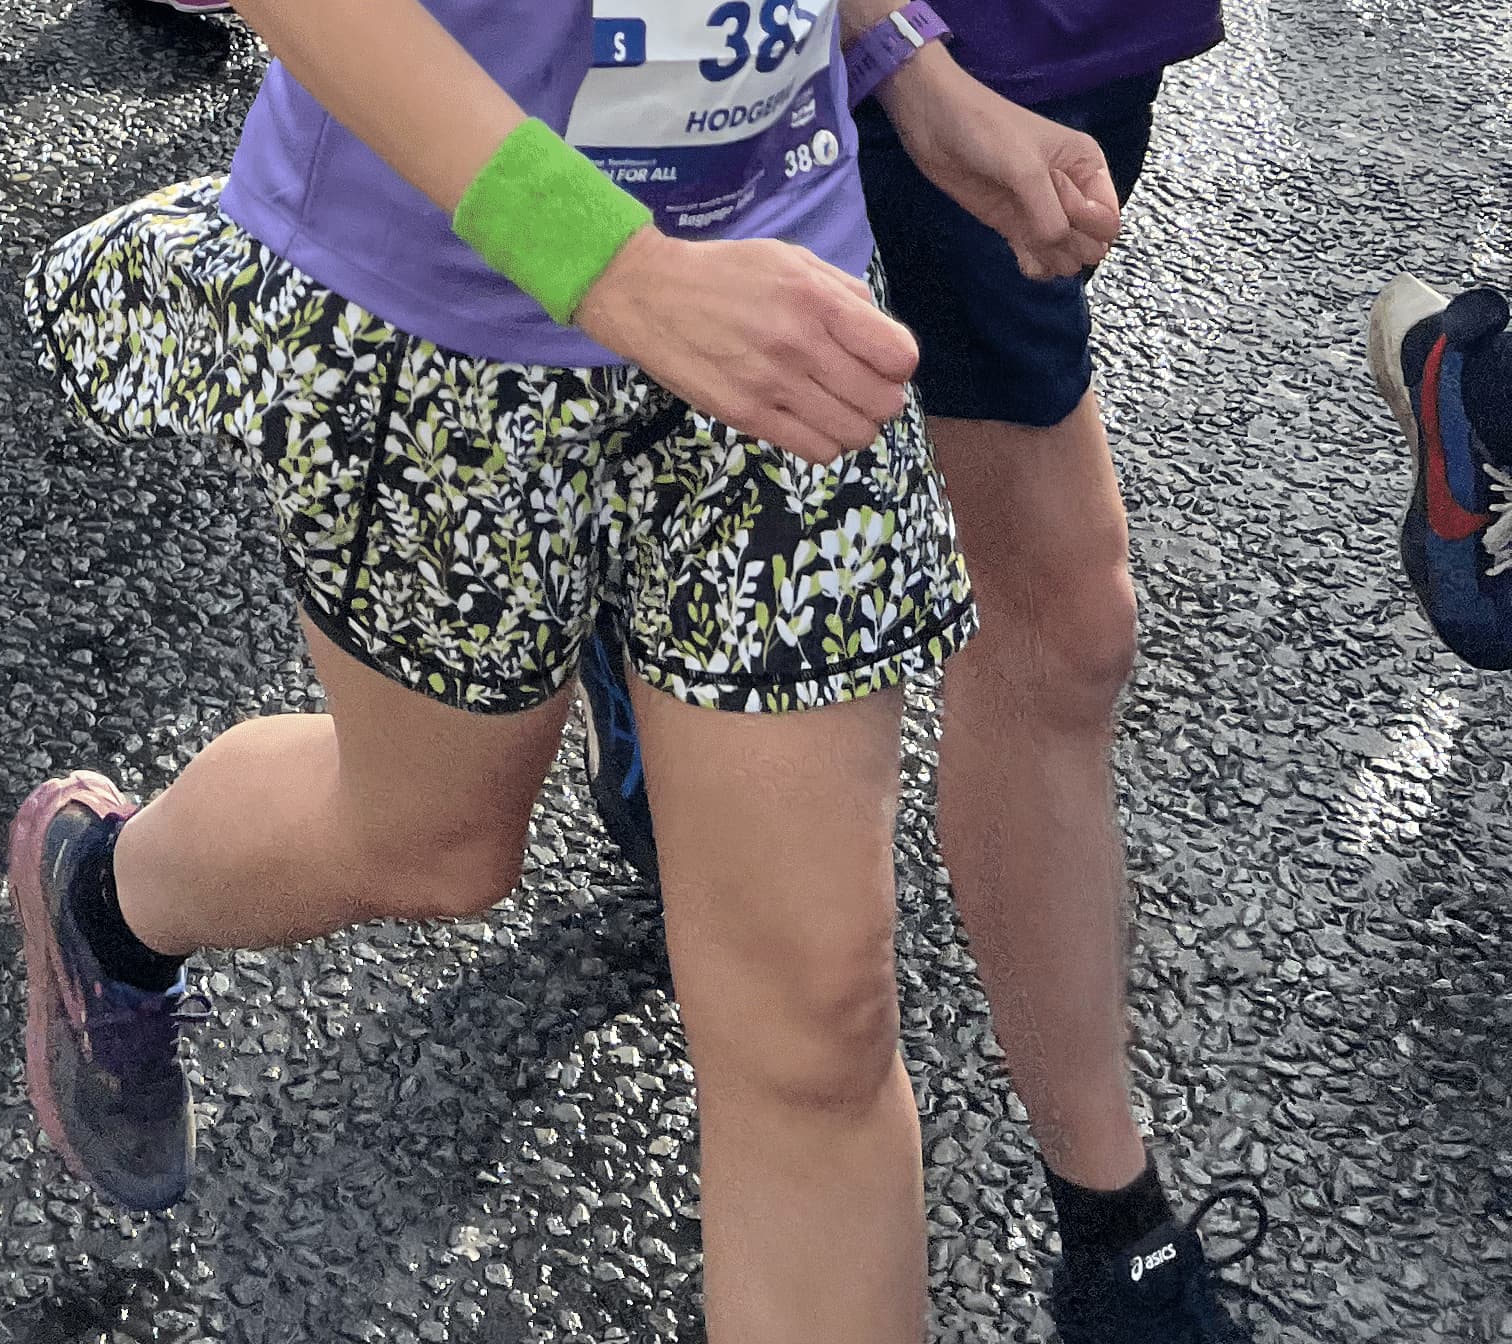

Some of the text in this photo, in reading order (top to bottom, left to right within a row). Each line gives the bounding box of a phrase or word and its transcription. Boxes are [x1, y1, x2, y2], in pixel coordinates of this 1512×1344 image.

[612, 31, 627, 62] S
[615, 166, 678, 183] FOR ALL
[784, 143, 814, 178] 38
